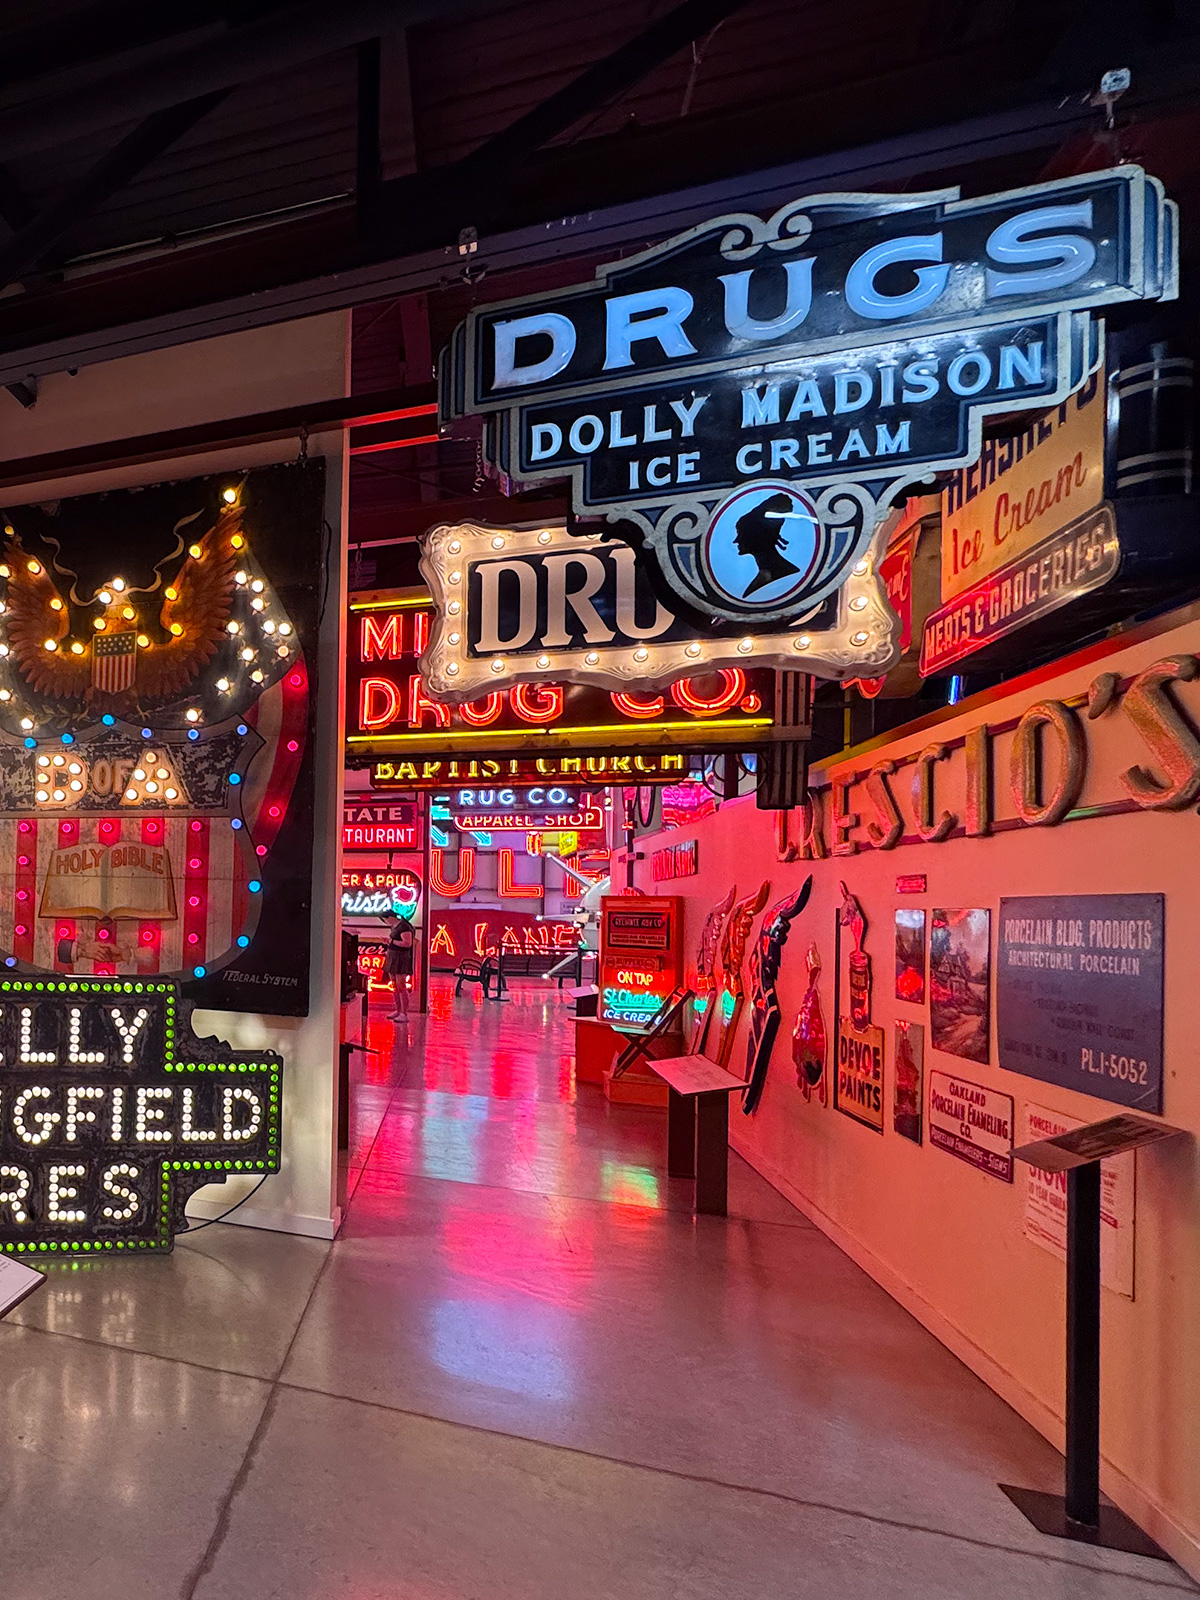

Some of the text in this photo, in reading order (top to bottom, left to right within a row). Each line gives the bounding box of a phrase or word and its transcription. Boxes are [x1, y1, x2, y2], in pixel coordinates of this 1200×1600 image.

[491, 200, 1097, 390] DRUGS
[529, 341, 1046, 462] DOLLY MADISON
[629, 420, 911, 490] ICE CREAM
[951, 451, 1087, 575] Ice Cream
[924, 603, 971, 660] MEATS
[988, 523, 1107, 626] GROCERIES
[358, 674, 564, 731] DRUG
[35, 752, 88, 807] D
[119, 749, 191, 806] A
[459, 787, 575, 806] RUG CO.
[462, 812, 595, 826] APPAREL SHOP
[343, 828, 415, 843] TAURANT
[56, 847, 164, 876] HOLY BIBLE
[376, 875, 415, 886] PAUL
[1003, 919, 1152, 951] PORCELAIN BLDG. PRODUCTS
[1007, 949, 1140, 976] ARCHITECTURAL PORCELAIN
[222, 970, 298, 987] FEDERAL SYSTEM
[617, 971, 654, 986] ON TAP
[603, 1008, 621, 1020] ICE
[840, 1035, 881, 1081] DEVOE
[839, 1070, 881, 1112] PAINTS
[949, 1081, 986, 1107] OAKLAND
[931, 1089, 966, 1121] PORCELAIN
[968, 1103, 1008, 1140] ENAMELING
[960, 1122, 972, 1140] CO.
